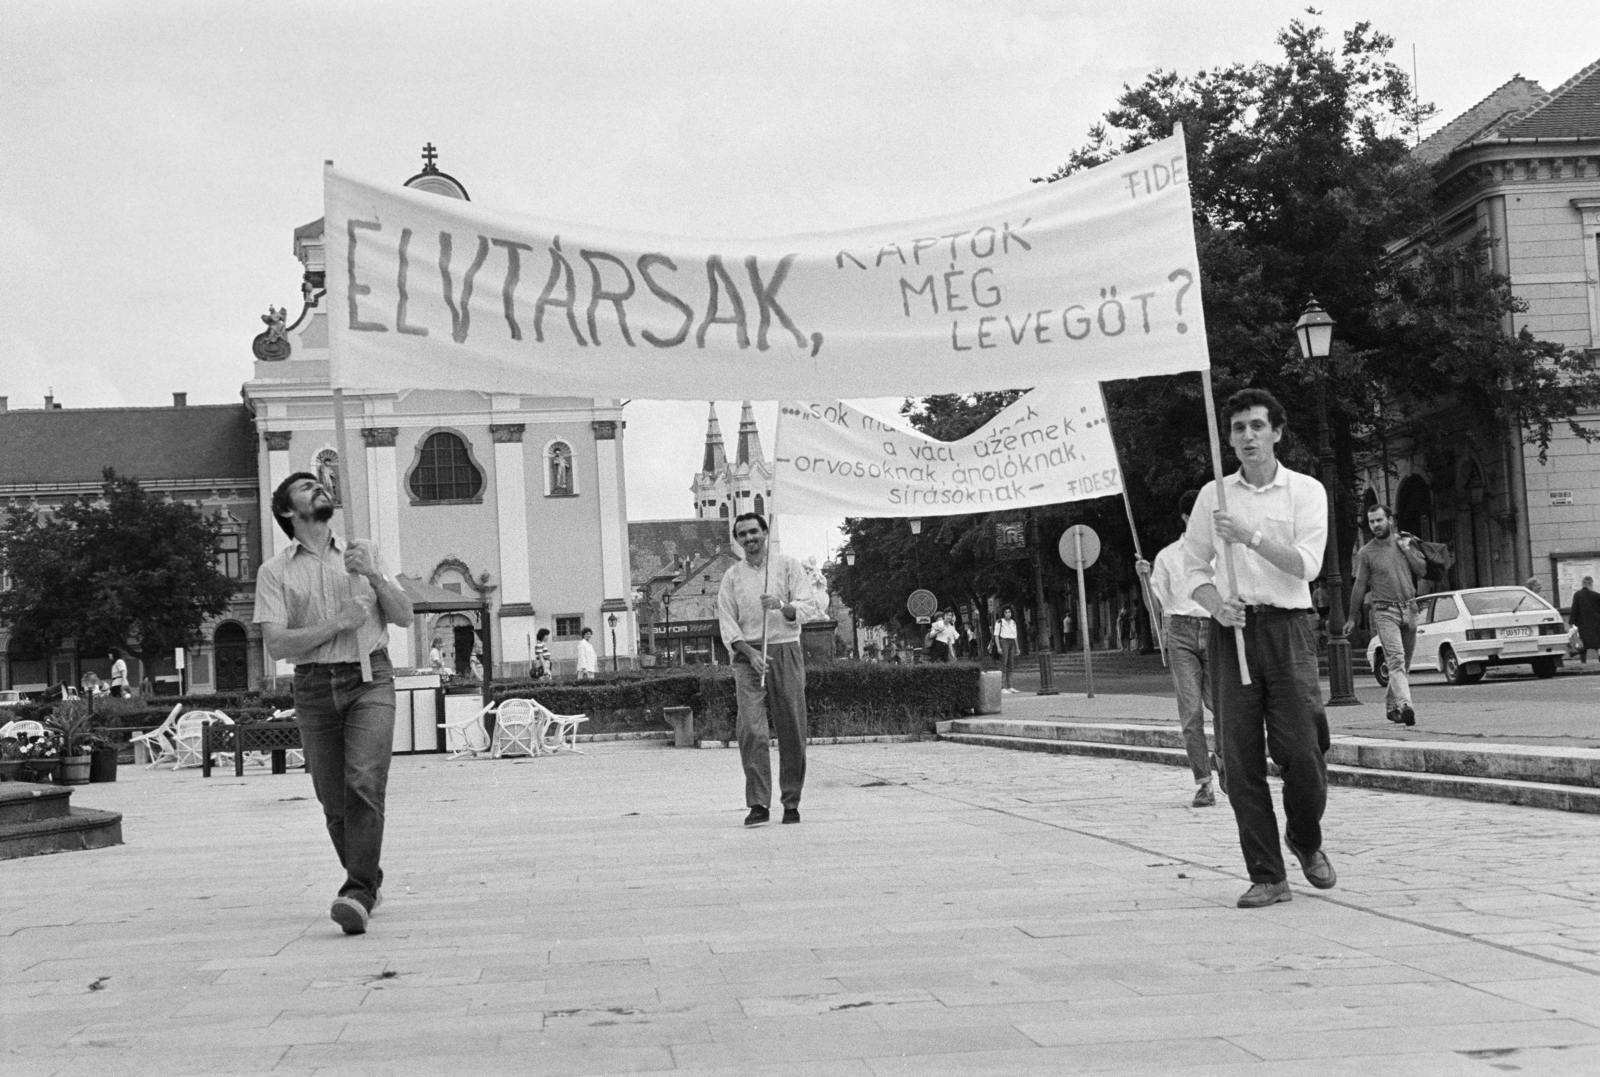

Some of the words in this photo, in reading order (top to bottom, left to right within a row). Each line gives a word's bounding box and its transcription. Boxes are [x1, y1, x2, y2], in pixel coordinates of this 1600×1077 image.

[836, 217, 1032, 270] KAPTOK
[346, 219, 824, 357] ELVTÁRSAK,
[900, 262, 1001, 317] MÉG
[883, 441, 897, 456] a
[1067, 468, 1118, 497] FIDESZ
